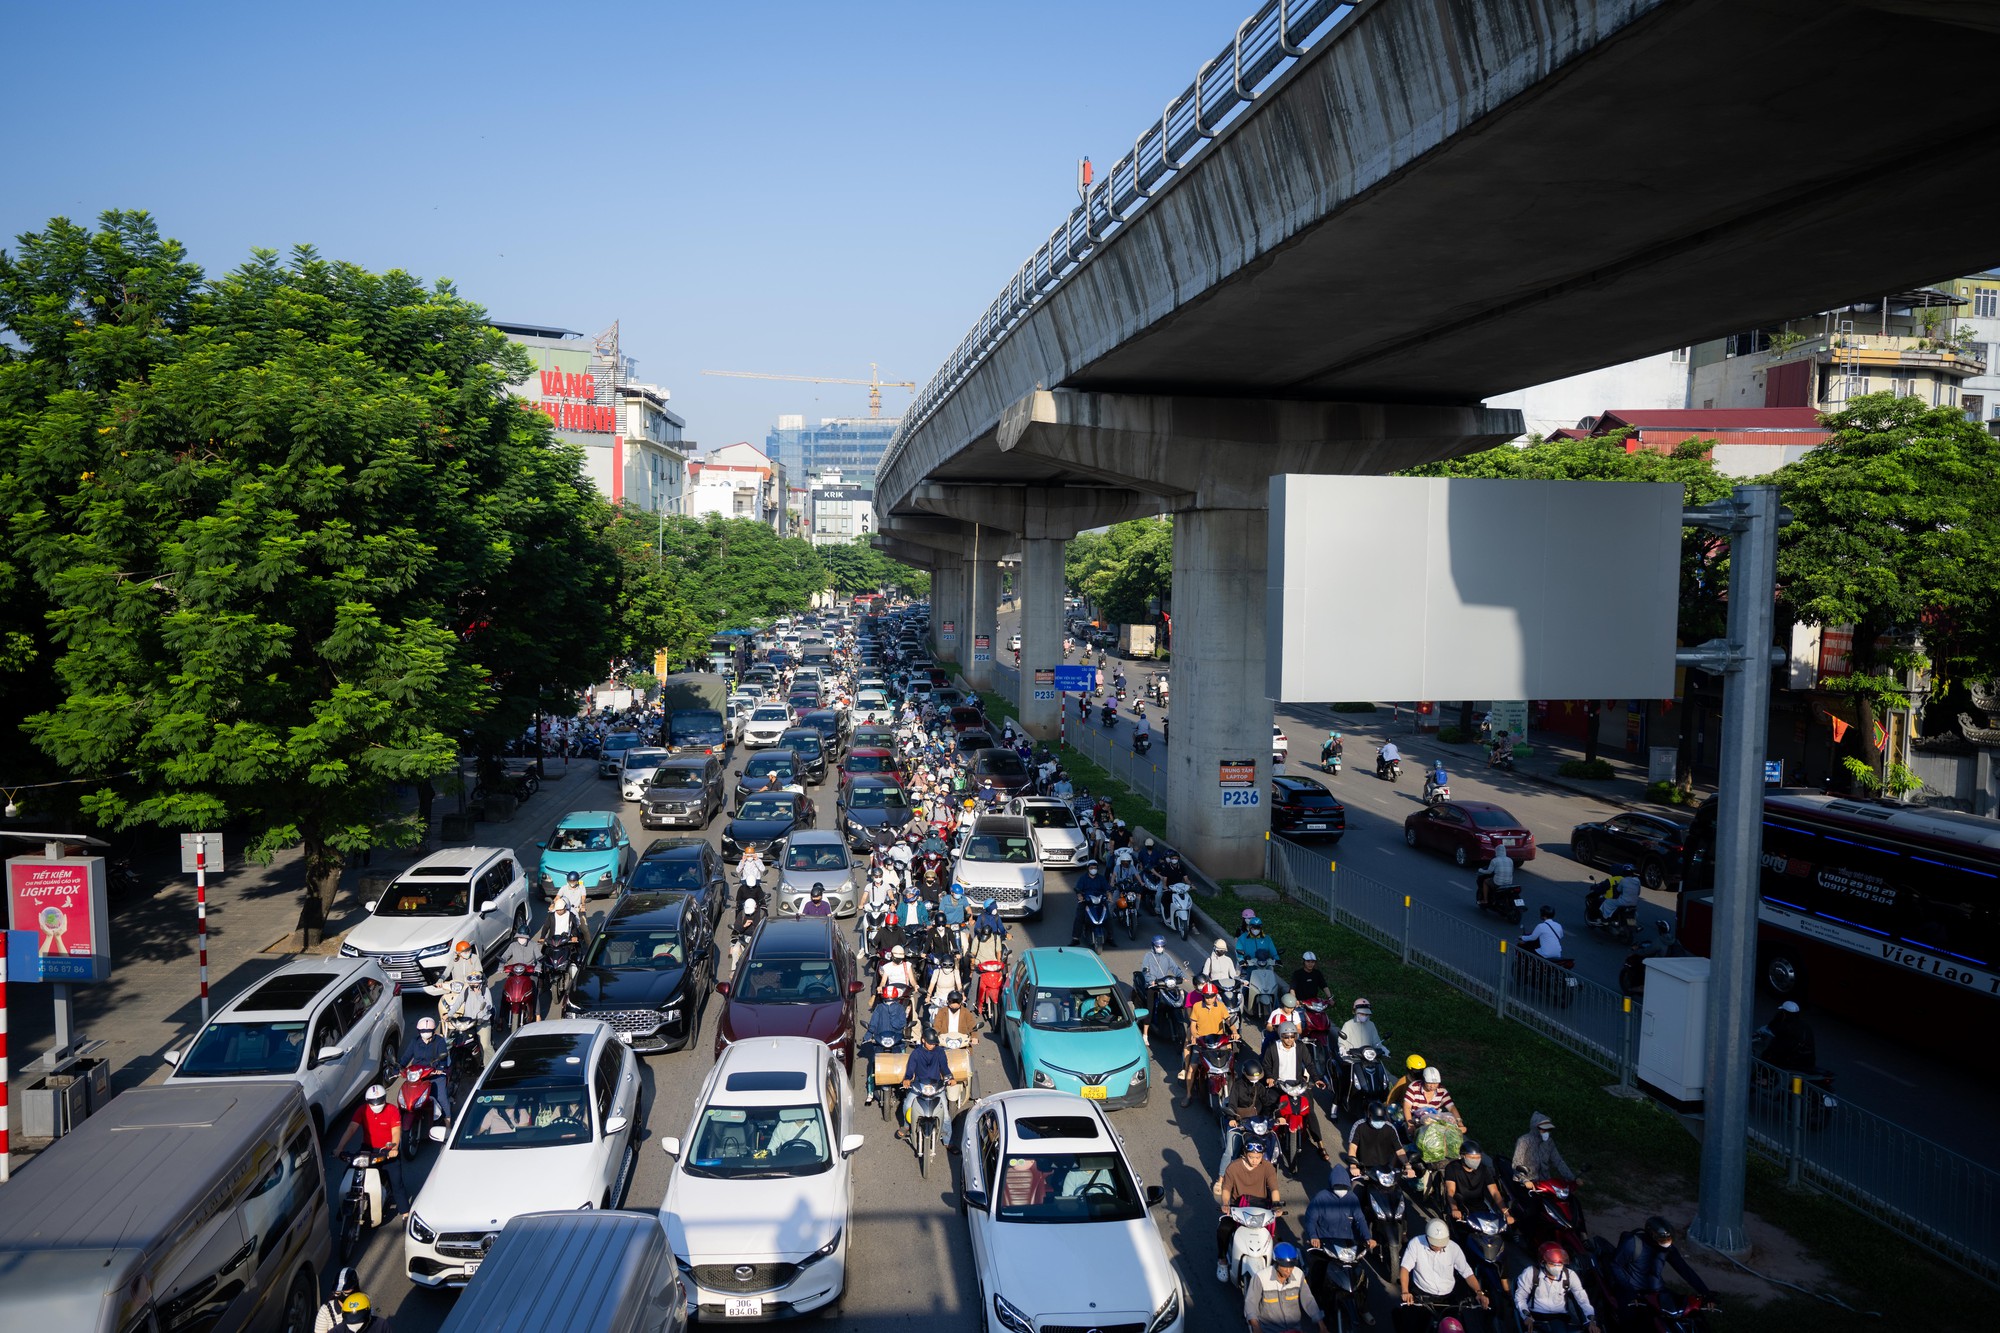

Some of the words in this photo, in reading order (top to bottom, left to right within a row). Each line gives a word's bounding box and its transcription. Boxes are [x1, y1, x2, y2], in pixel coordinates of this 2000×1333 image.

[540, 366, 594, 399] VÀNG
[564, 403, 616, 431] MINH
[1034, 691, 1055, 699] P235
[1223, 790, 1259, 806] P236
[32, 870, 50, 880] TIẾT
[50, 869, 72, 880] KIỆM
[20, 886, 55, 897] LIGHT
[54, 885, 81, 896] BOX
[1823, 881, 1847, 892] 0917
[1849, 887, 1869, 899] 750
[1871, 894, 1894, 906] 504
[1824, 873, 1848, 884] 1900
[1849, 879, 1863, 888] 29
[1865, 883, 1880, 893] 99
[1881, 888, 1897, 898] 29
[73, 965, 85, 973] 86
[1882, 944, 1926, 970] Viet
[1932, 960, 1974, 985] Lao
[736, 1299, 752, 1307] 30G
